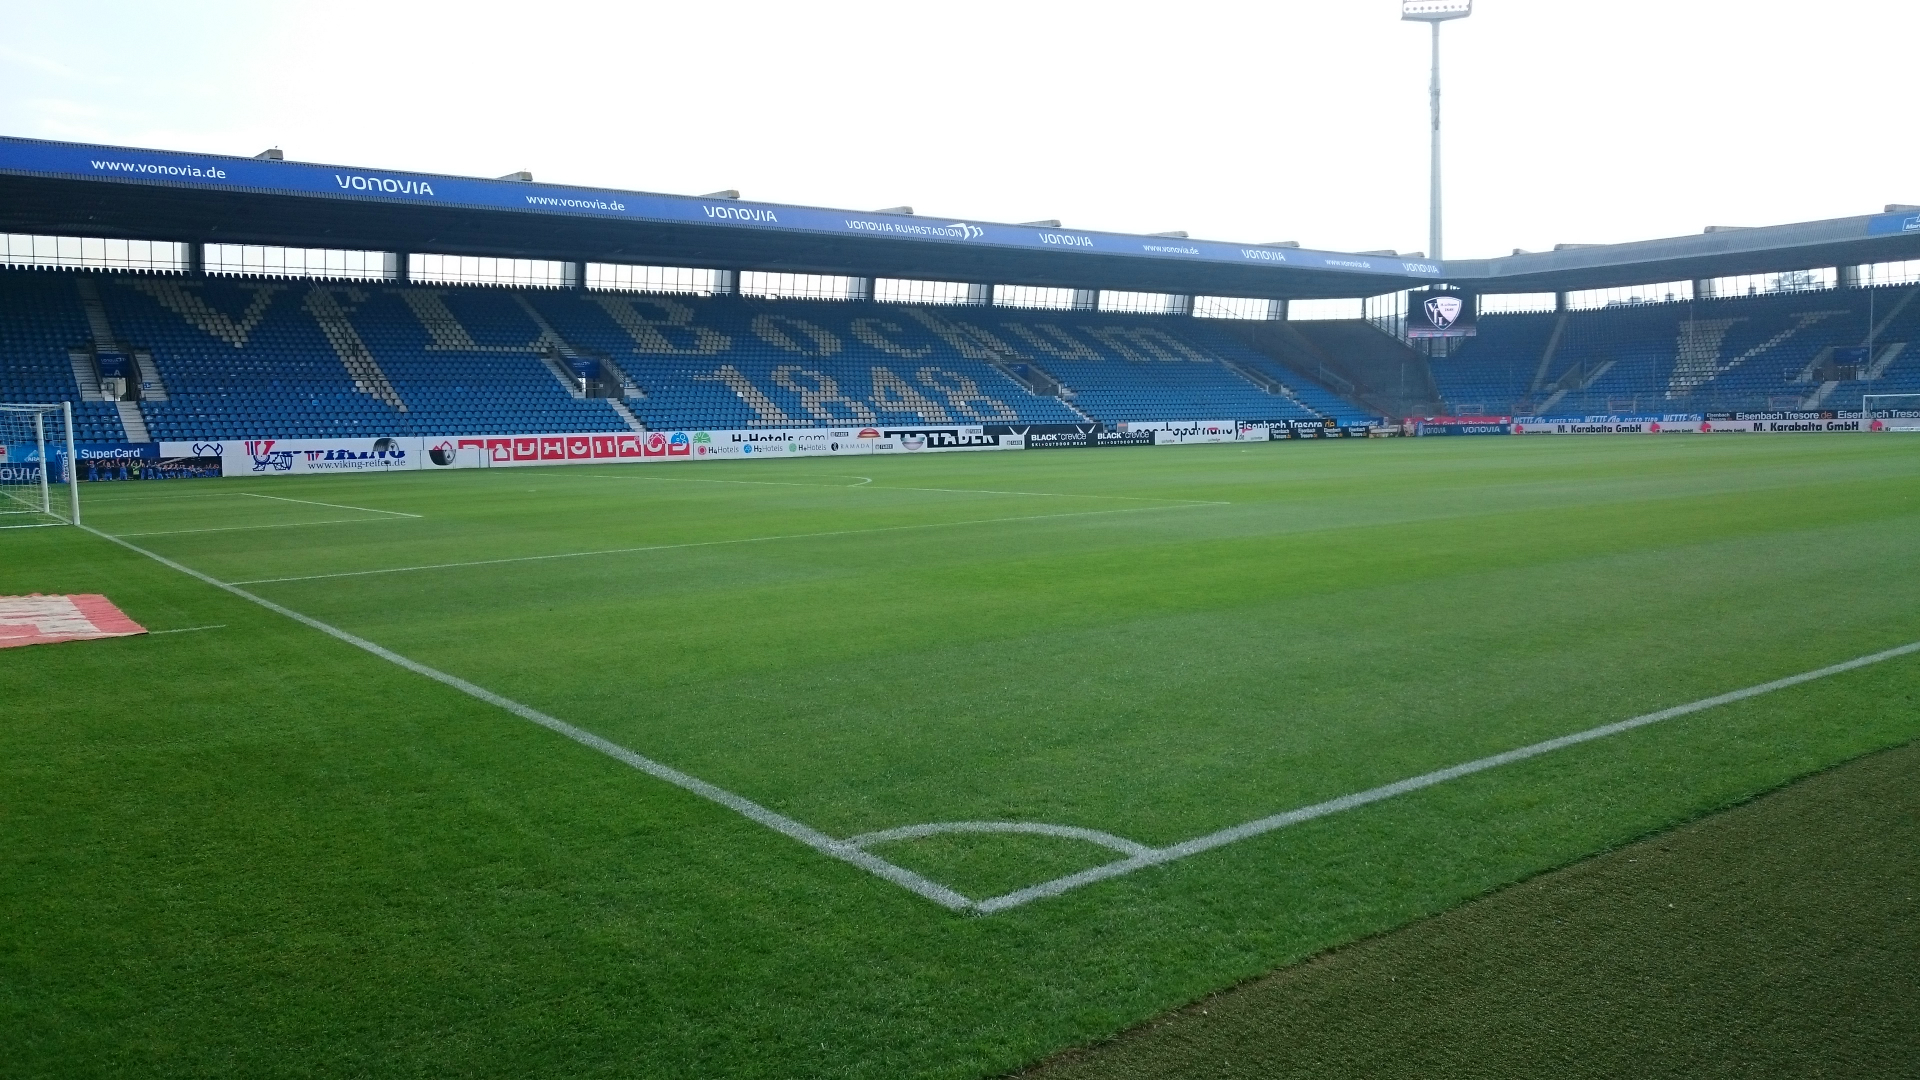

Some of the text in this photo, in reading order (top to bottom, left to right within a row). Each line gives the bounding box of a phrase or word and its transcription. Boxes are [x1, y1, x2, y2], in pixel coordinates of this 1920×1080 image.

[91, 159, 226, 179] www.vonovia.de
[334, 174, 434, 196] VONOVIA
[525, 195, 626, 211] www.vonovia.de
[702, 205, 778, 223] VONOVIA
[845, 220, 963, 238] VONOVIA RUHRSTADION
[1038, 233, 1094, 247] VONOVIA
[1142, 244, 1200, 255] www.vonovia.de
[1241, 249, 1286, 261] VONOVIA
[1324, 259, 1371, 269] www.vonovia.de
[1402, 263, 1440, 274] VONOVIA
[692, 364, 1019, 425] 1848
[1736, 412, 1782, 420] Eisenbach
[1837, 410, 1889, 419] Eisenbach
[1462, 425, 1501, 434] VONOVIA
[1557, 425, 1568, 434] M.
[1615, 424, 1642, 433] GmbH
[1753, 422, 1766, 432] M.
[1826, 421, 1859, 431] GmbH
[731, 432, 825, 442] H-Hotelscom
[1031, 433, 1057, 441] BLACK
[840, 442, 870, 450] RAMADA
[81, 447, 140, 459] SuperCard
